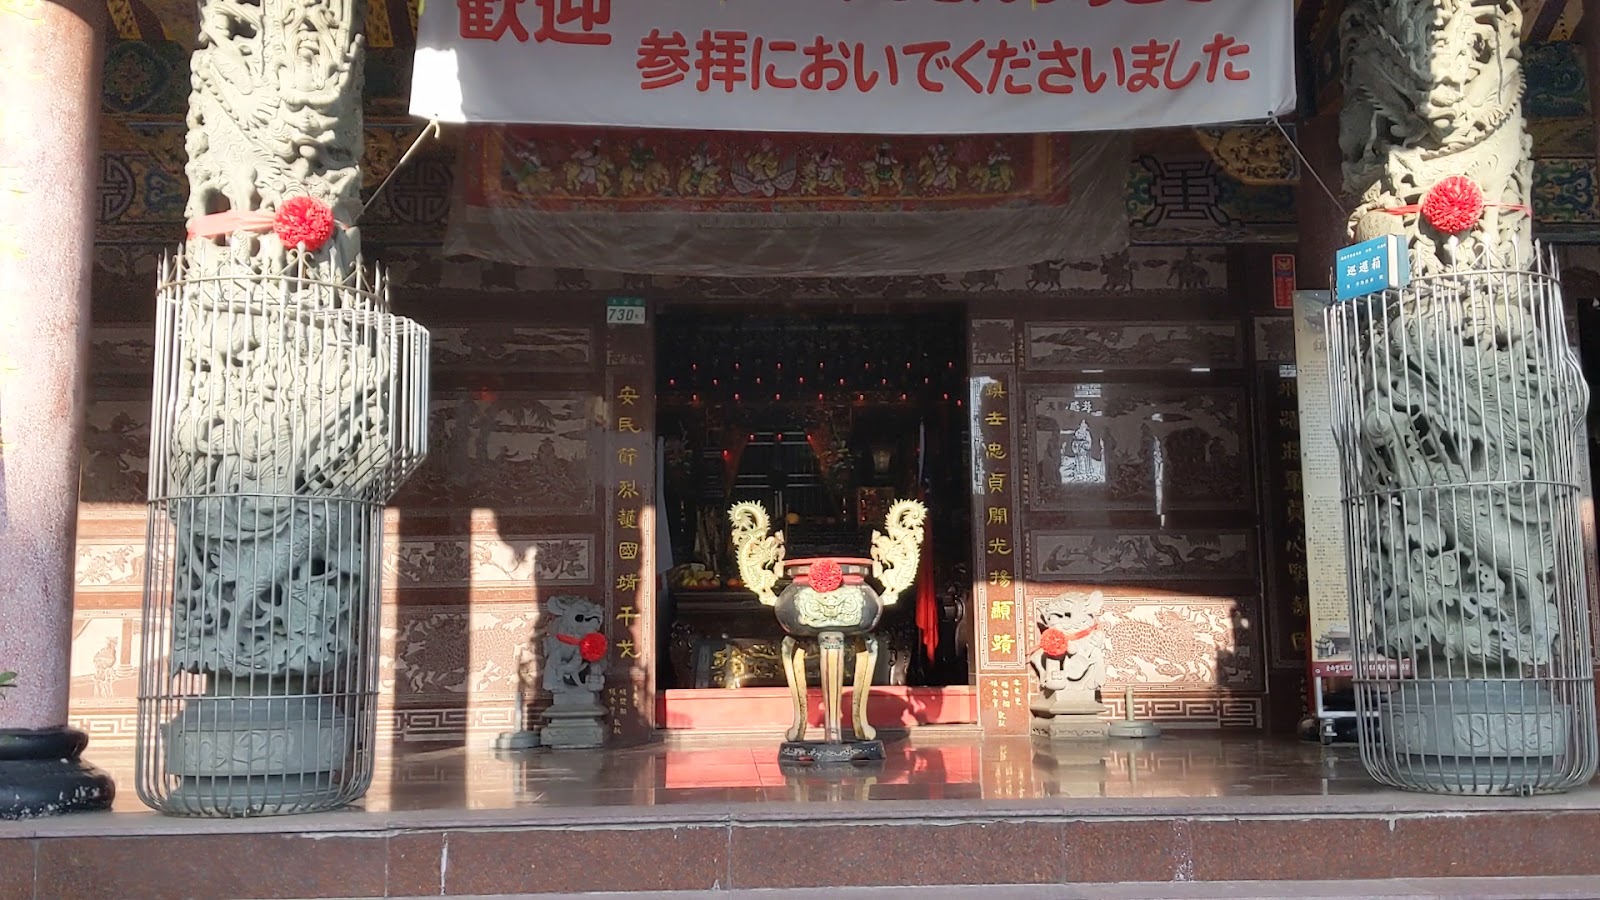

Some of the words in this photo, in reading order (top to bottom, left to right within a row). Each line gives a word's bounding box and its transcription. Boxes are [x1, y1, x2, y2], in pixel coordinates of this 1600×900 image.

[636, 31, 1250, 95] 参拝においでくださいました
[608, 308, 634, 321] 730
